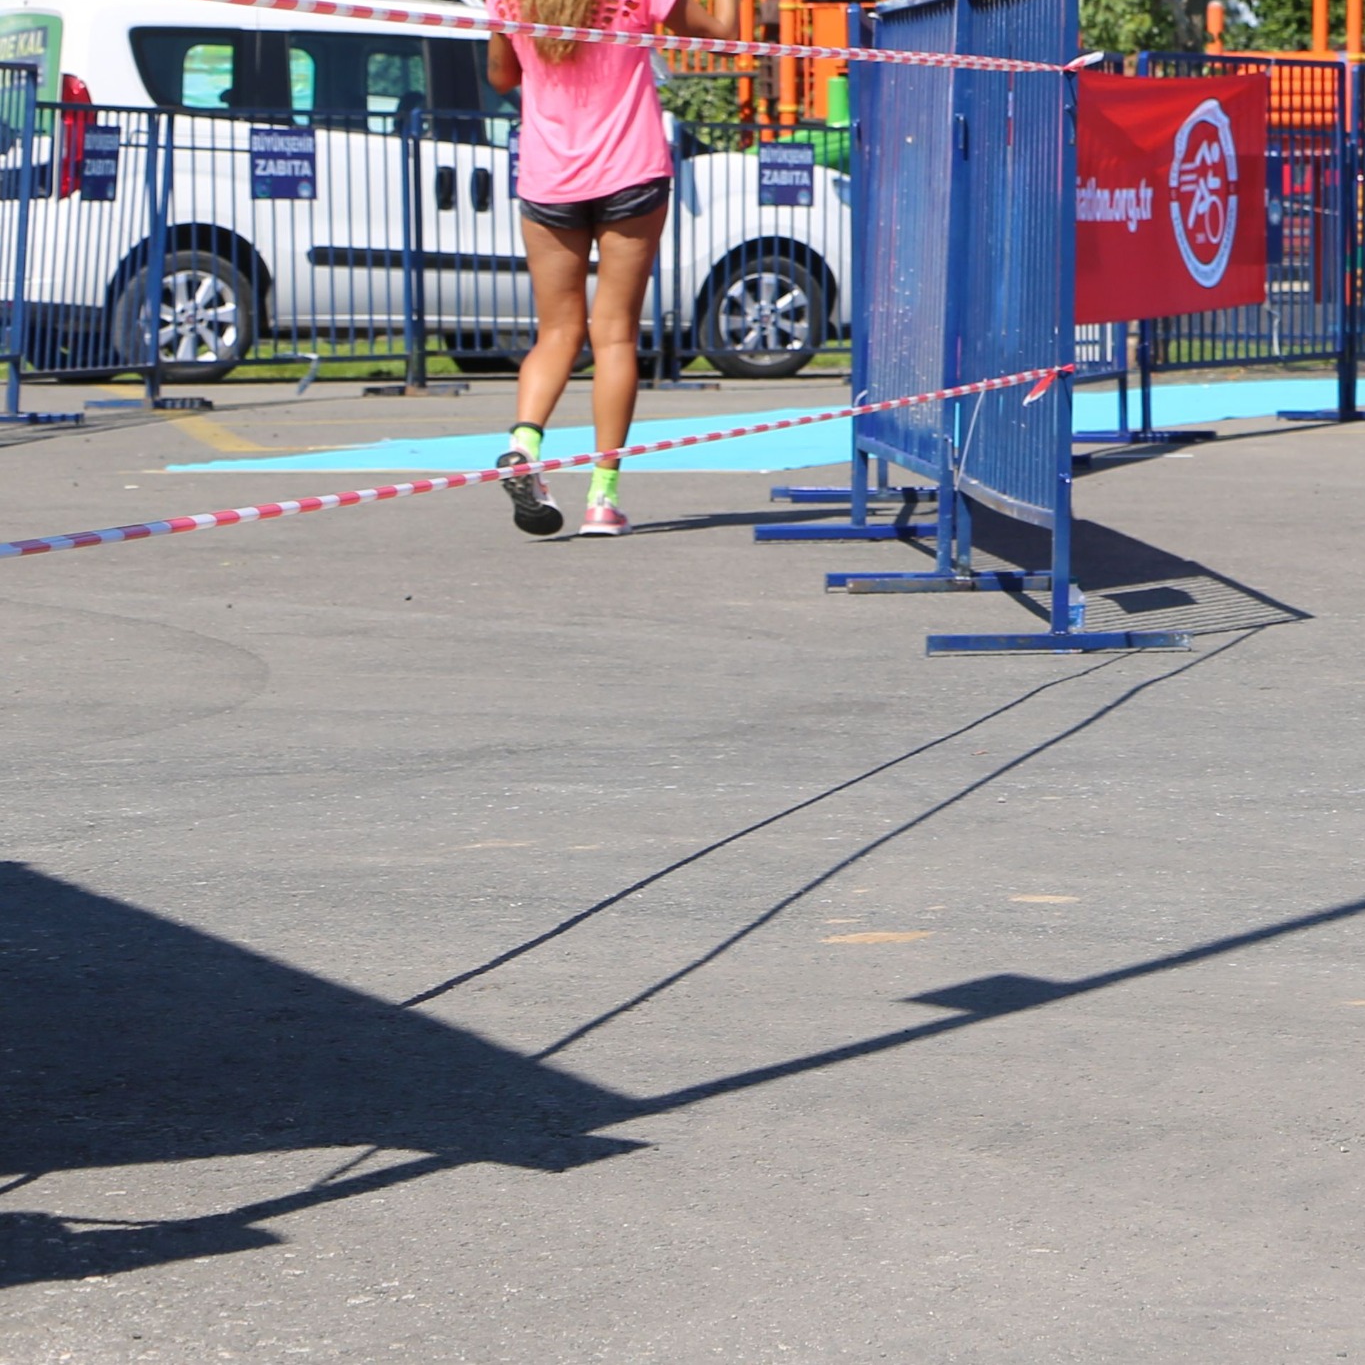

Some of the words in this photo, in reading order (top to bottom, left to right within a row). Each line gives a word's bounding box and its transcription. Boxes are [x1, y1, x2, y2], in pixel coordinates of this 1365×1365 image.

[251, 132, 314, 156] BÜYÜKŞEHİR
[84, 159, 117, 176] ZABITA
[254, 159, 313, 177] ZABITA
[761, 169, 811, 186] ZABITA
